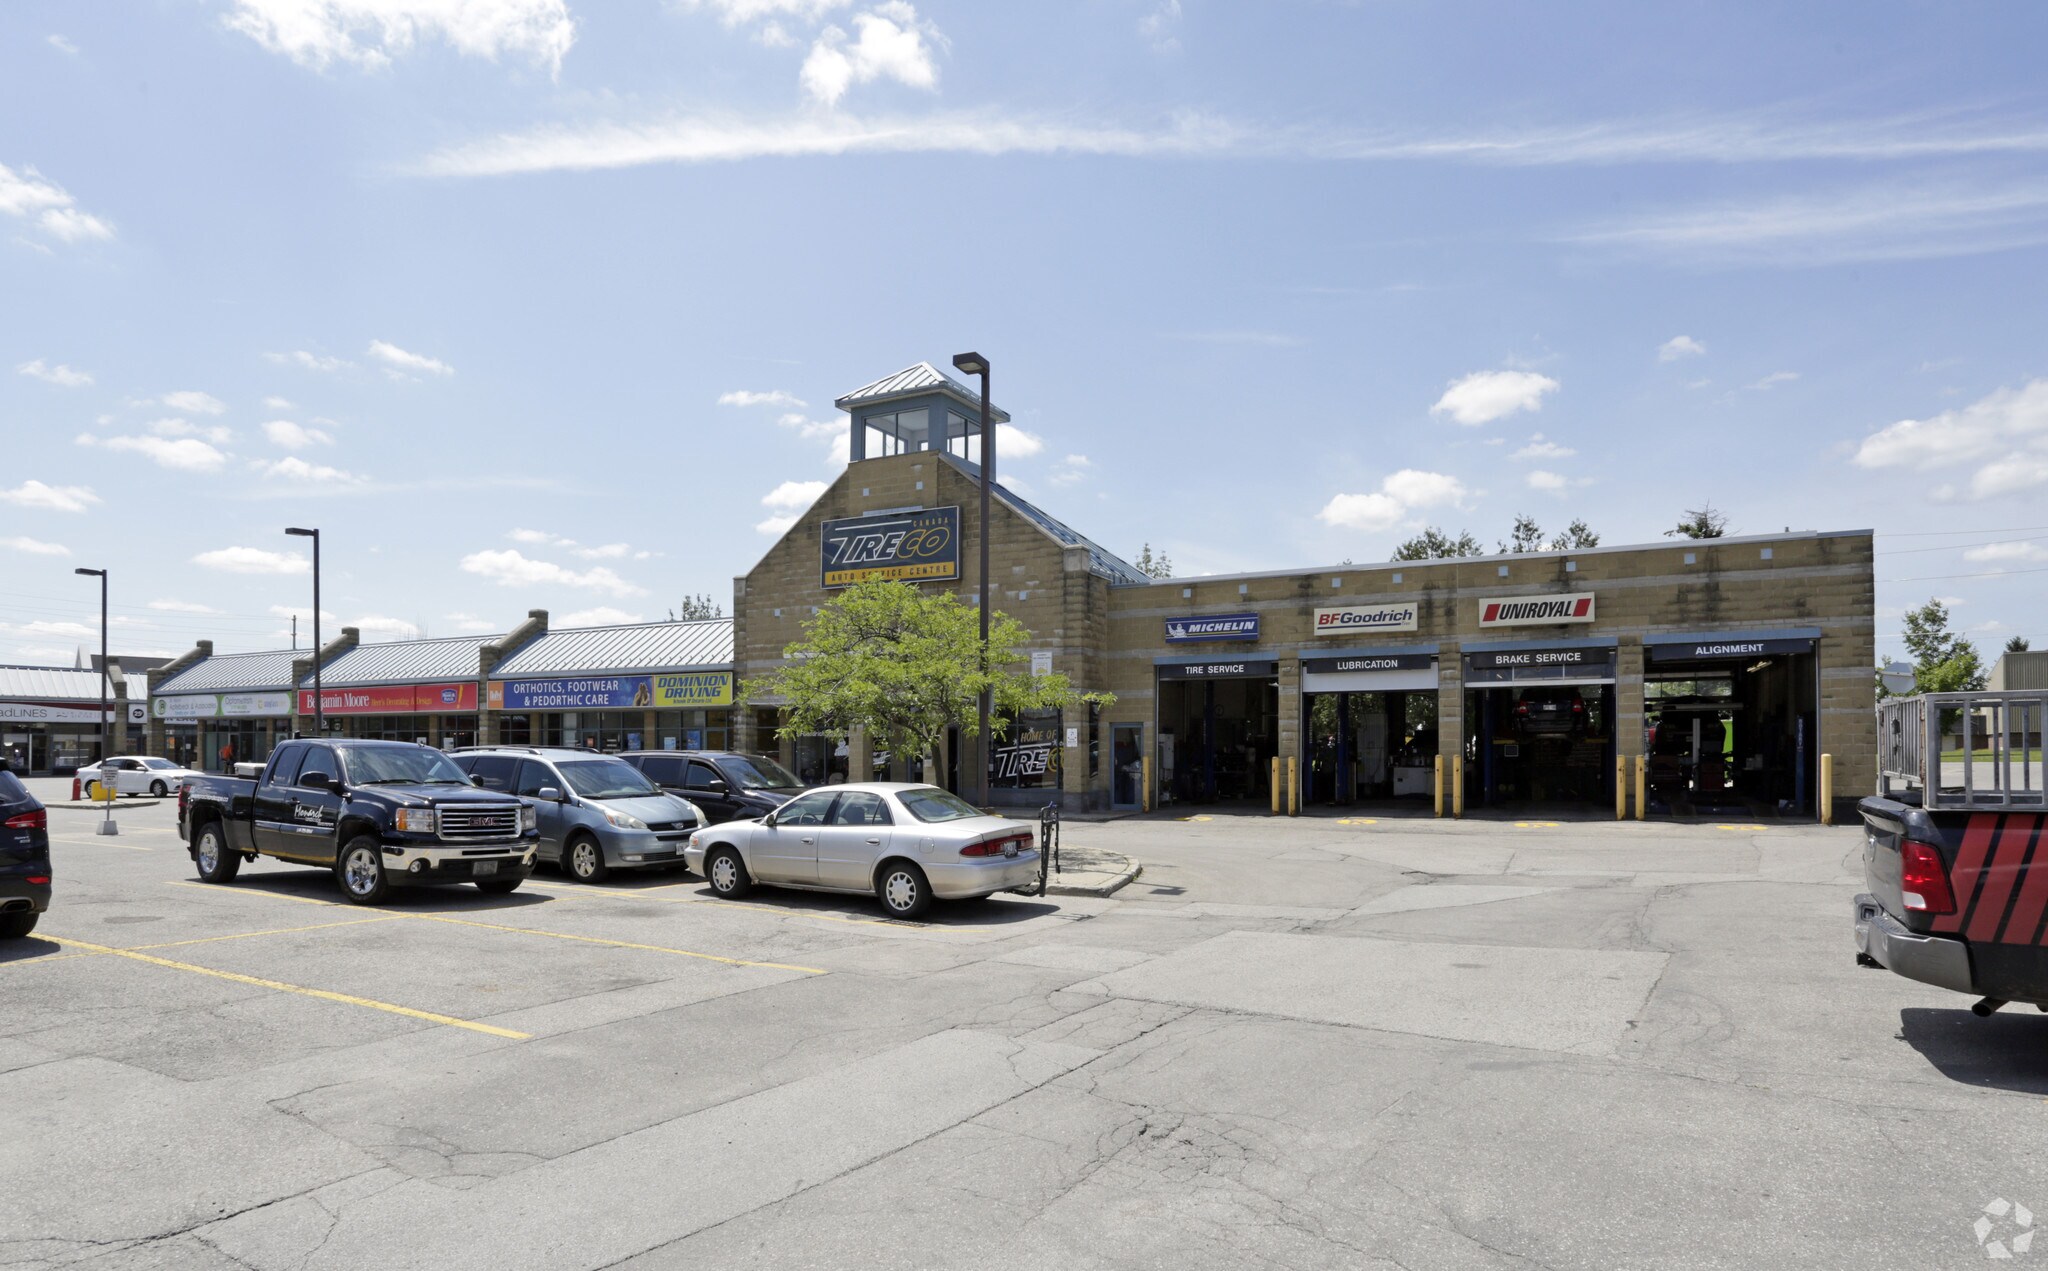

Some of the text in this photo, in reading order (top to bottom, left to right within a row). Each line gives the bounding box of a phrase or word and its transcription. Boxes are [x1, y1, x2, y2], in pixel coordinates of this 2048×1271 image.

[913, 517, 948, 528] CANADA
[829, 520, 950, 565] TIRECO
[831, 572, 855, 581] AUTO
[909, 565, 947, 575] CENTRE
[1498, 600, 1573, 620] UNIROYAL
[1318, 609, 1413, 626] BFGoodrich
[1188, 620, 1255, 633] MICHELIN
[1695, 643, 1764, 656] ALIGNMENT
[1337, 659, 1398, 671] LUBRICATION
[1495, 652, 1581, 665] BRAKE SERVICE
[1185, 664, 1244, 675] TIRE SERVICE
[513, 680, 619, 693] ORTHOTICS, FOOTWEAR
[658, 675, 729, 688] DOMINION
[664, 687, 721, 698] DRIVING
[306, 693, 370, 711] Bejamin Moore
[524, 694, 609, 706] & PEDORTHIC CARE
[1021, 731, 1044, 742] HOME
[1046, 729, 1057, 739] OF
[468, 817, 501, 827] GMC
